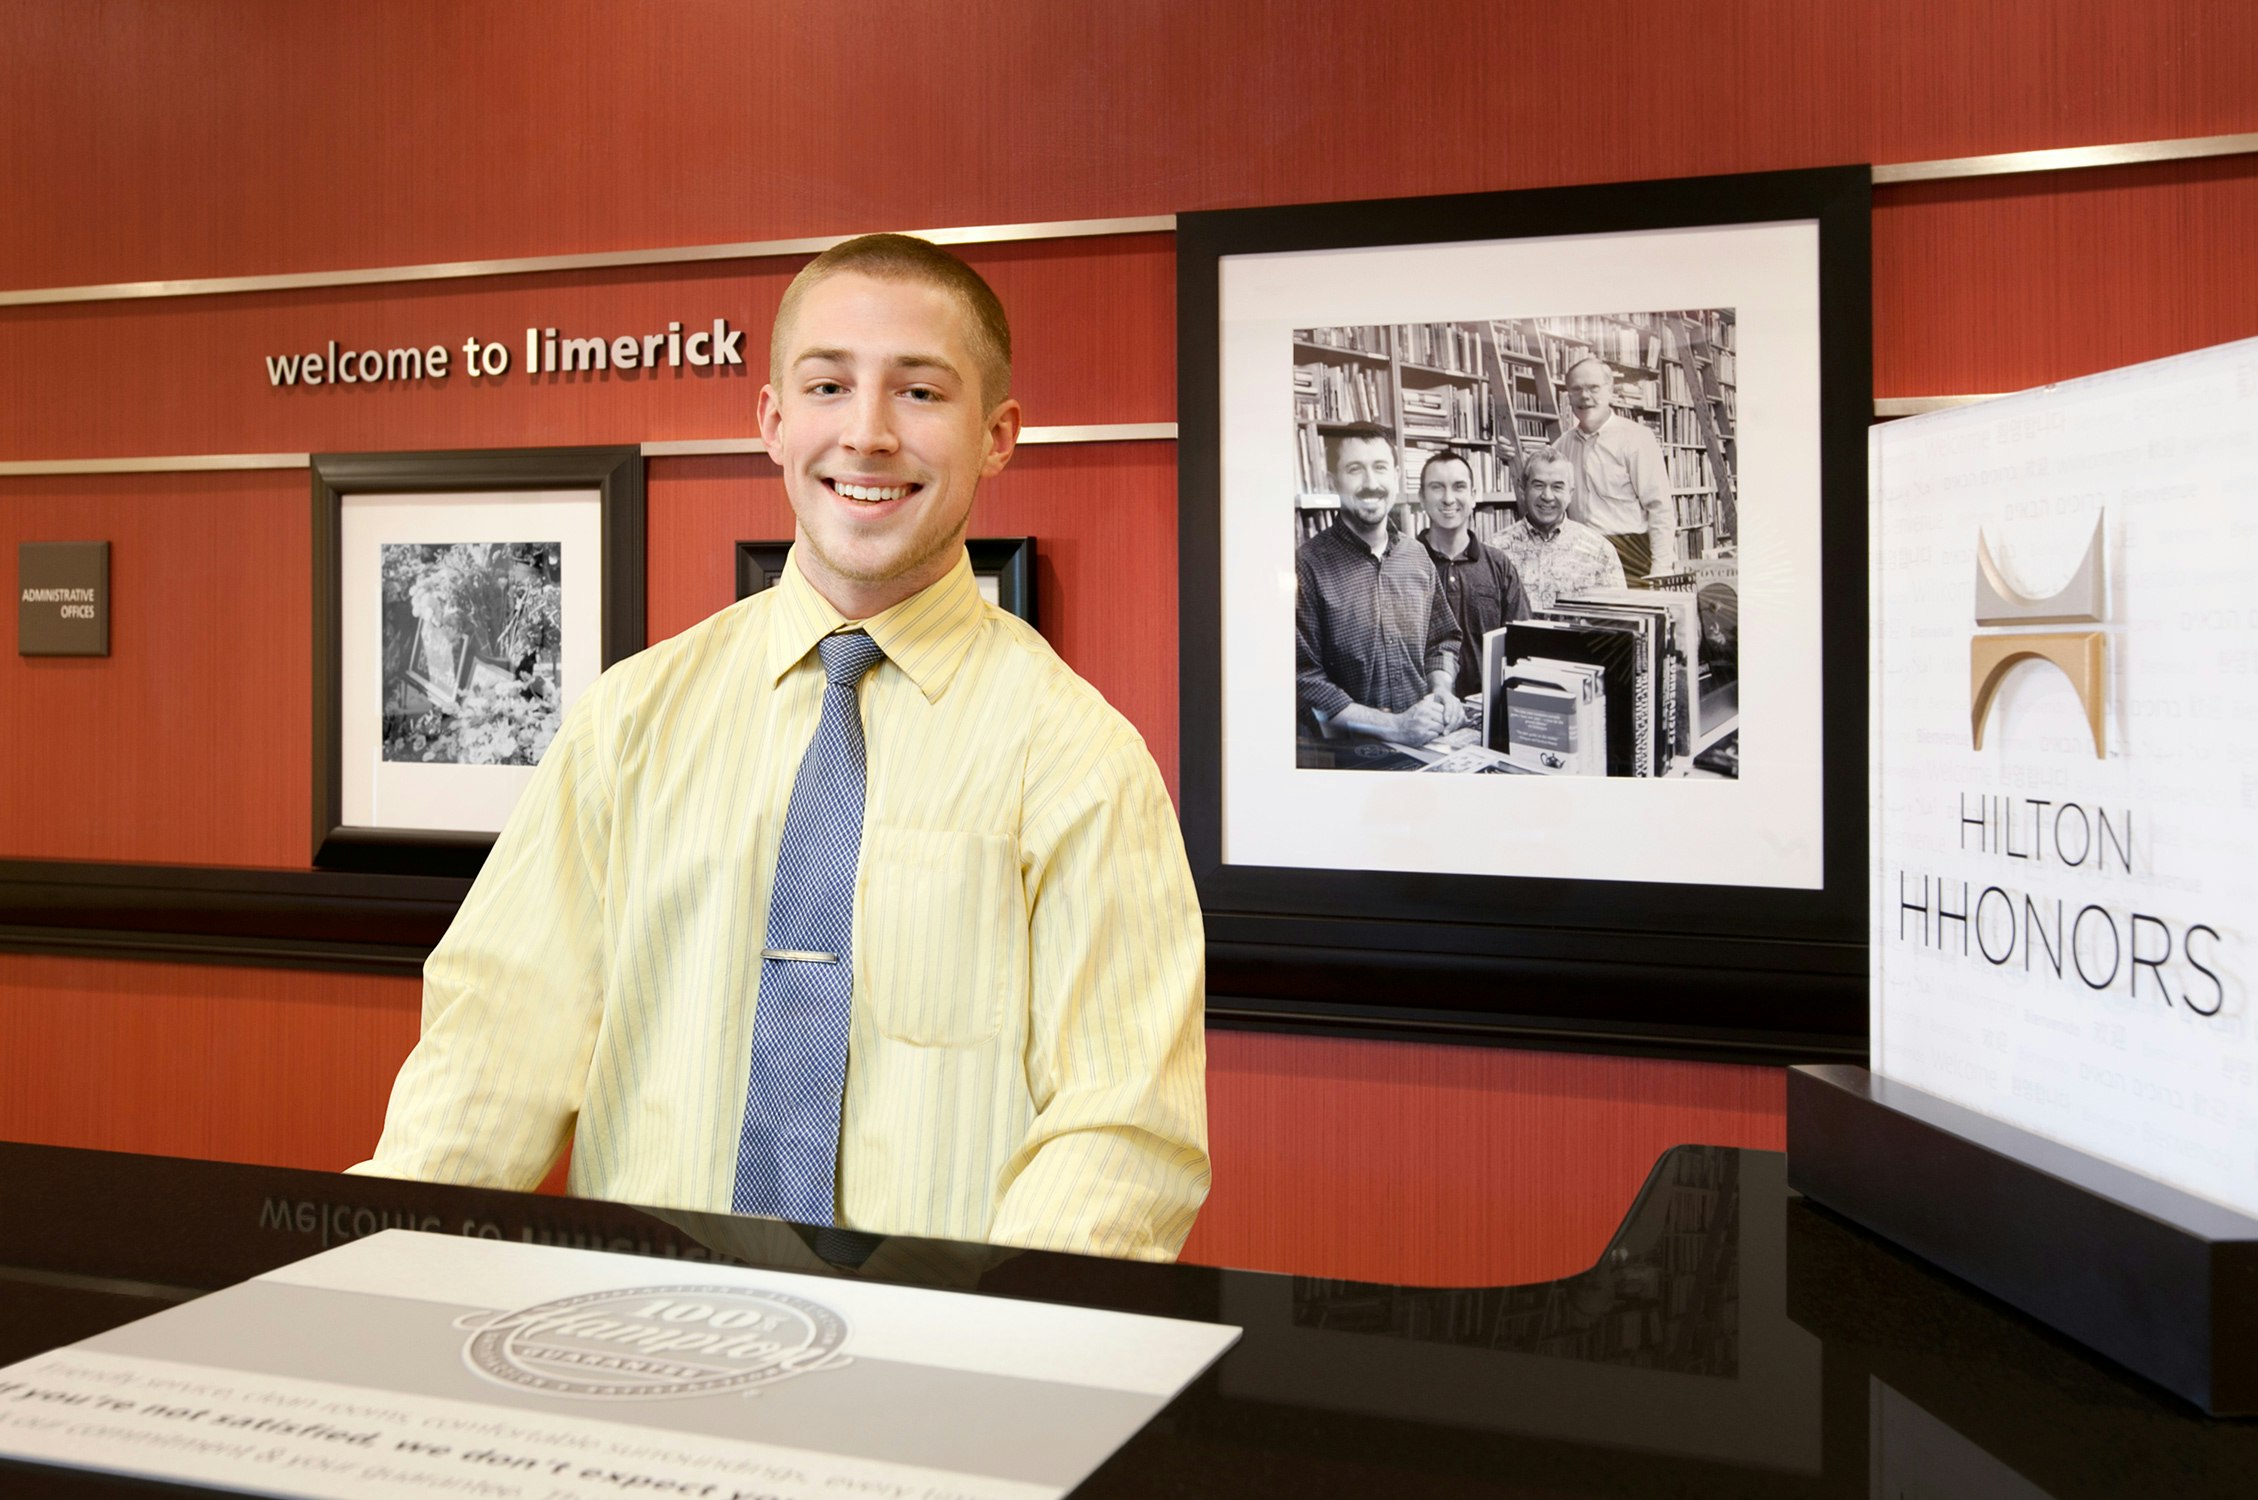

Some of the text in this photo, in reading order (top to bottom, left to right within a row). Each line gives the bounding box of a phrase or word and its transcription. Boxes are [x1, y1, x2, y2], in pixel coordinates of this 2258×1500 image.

[265, 318, 743, 386] welcome to limerick
[21, 588, 95, 602] ADMINISTRATIVE
[60, 604, 95, 619] OFFICES
[1961, 791, 2131, 875] HILTON
[1900, 869, 2224, 1017] HHONORS
[452, 1305, 855, 1371] Hampton
[521, 1347, 700, 1378] GUARANTEE
[10, 1388, 137, 1413] you're
[139, 1403, 211, 1421] not
[207, 1413, 383, 1448] satisfied,
[395, 1440, 451, 1457] we
[460, 1449, 571, 1475] don't
[578, 1467, 717, 1498] expect
[64, 1423, 257, 1460] commitment
[281, 1455, 360, 1474] your
[242, 1390, 318, 1409] clean
[420, 1416, 601, 1450] comfortable
[824, 1475, 917, 1499] every
